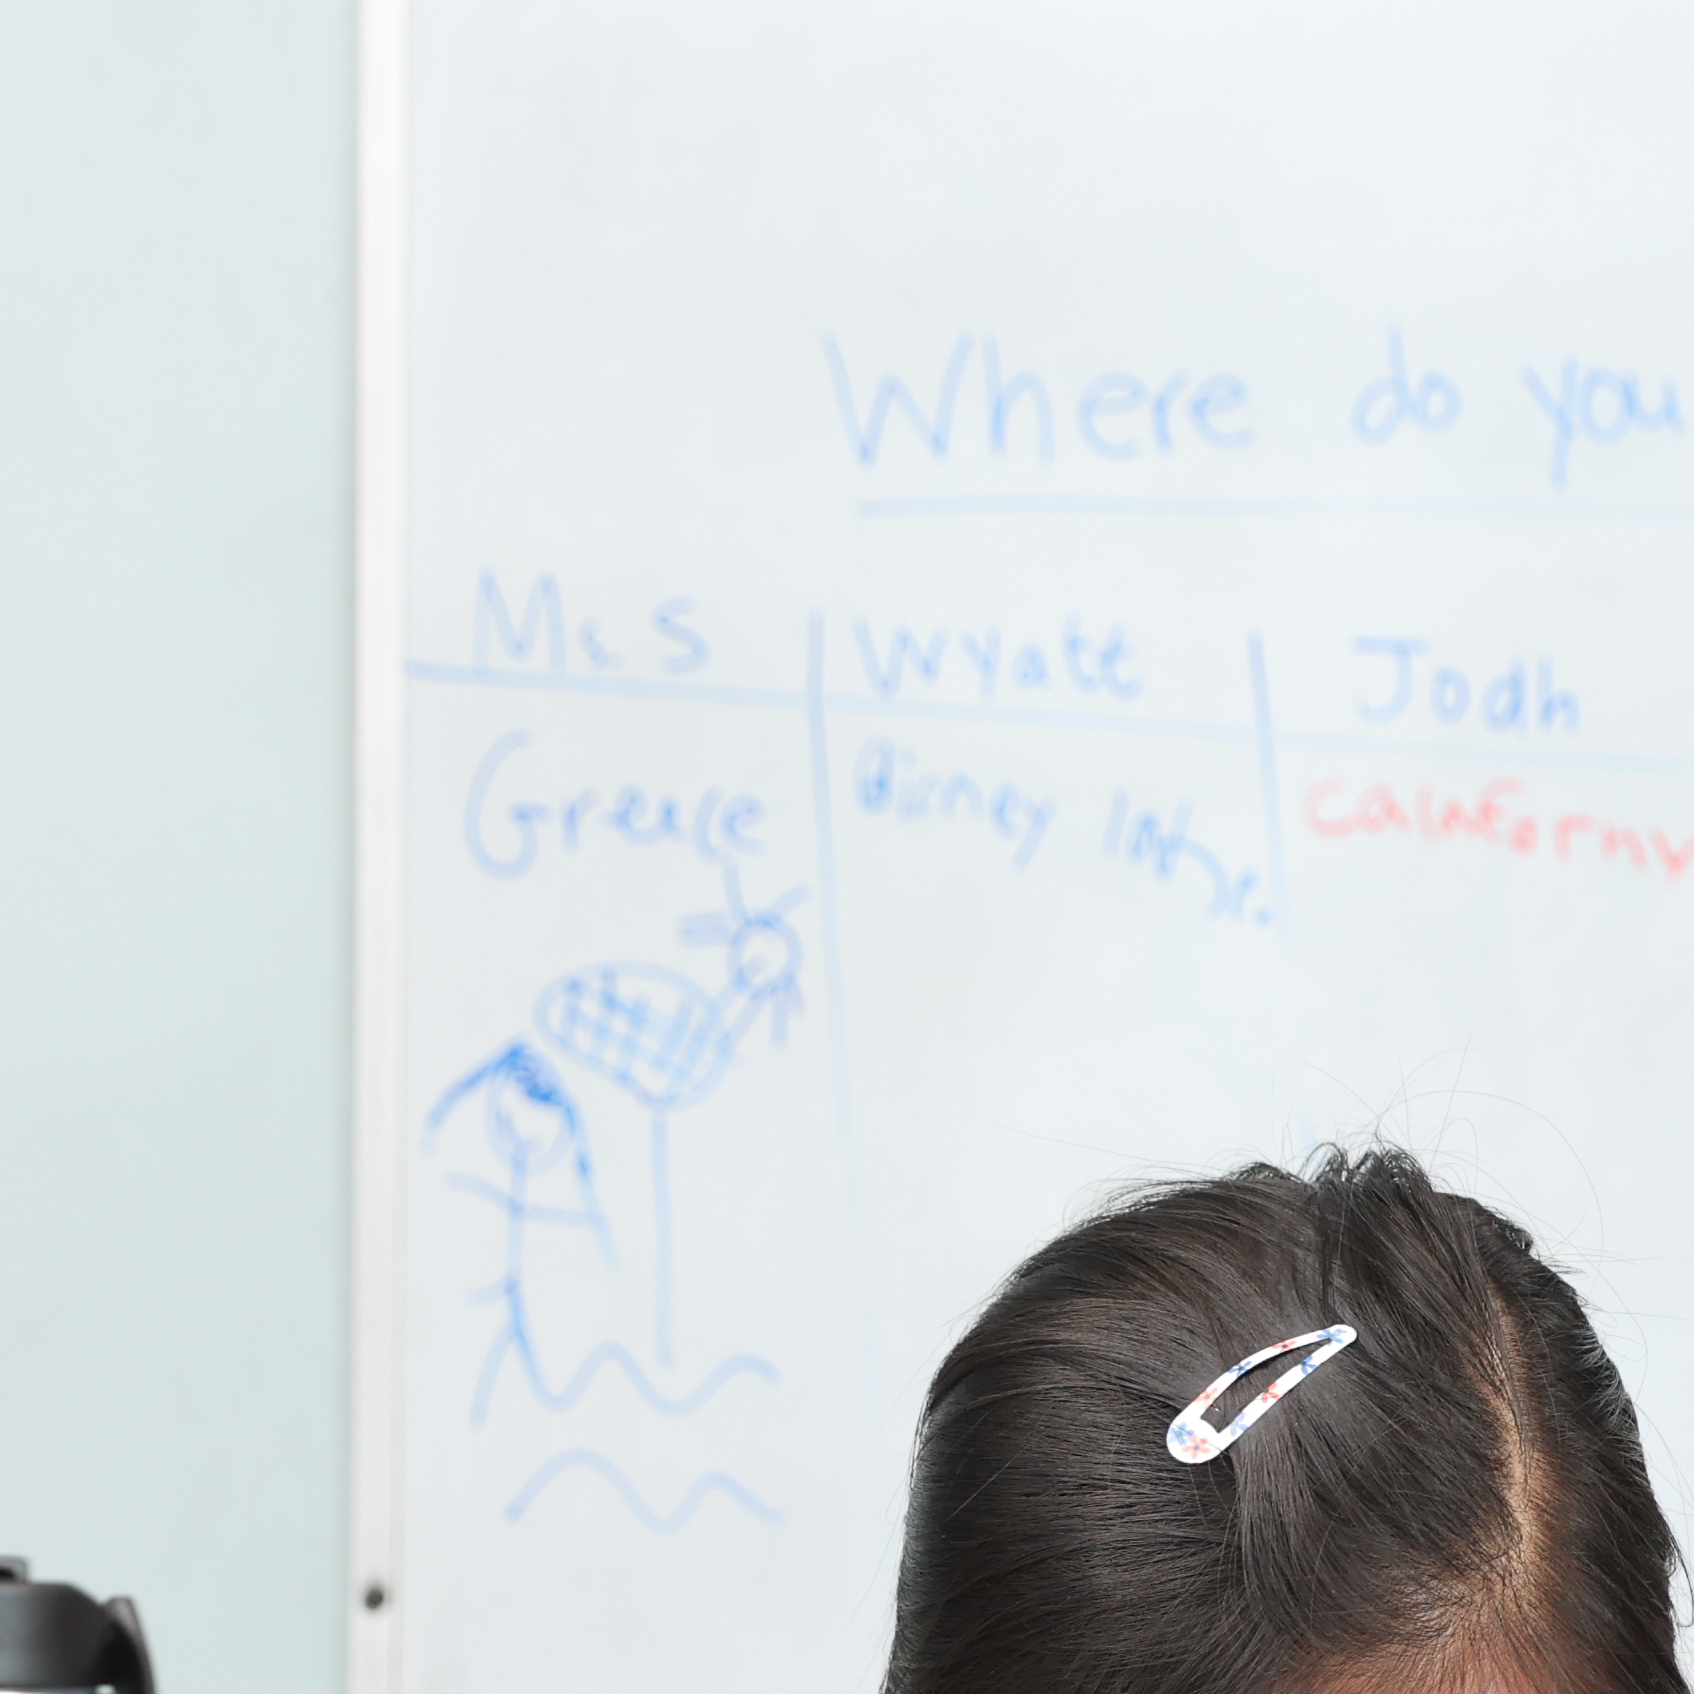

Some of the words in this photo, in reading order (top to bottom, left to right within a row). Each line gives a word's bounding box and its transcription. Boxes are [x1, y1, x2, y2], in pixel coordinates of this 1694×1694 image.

[821, 331, 1255, 469] Where
[1349, 325, 1464, 446] do
[1520, 357, 1685, 491] you
[465, 731, 764, 878] Greece
